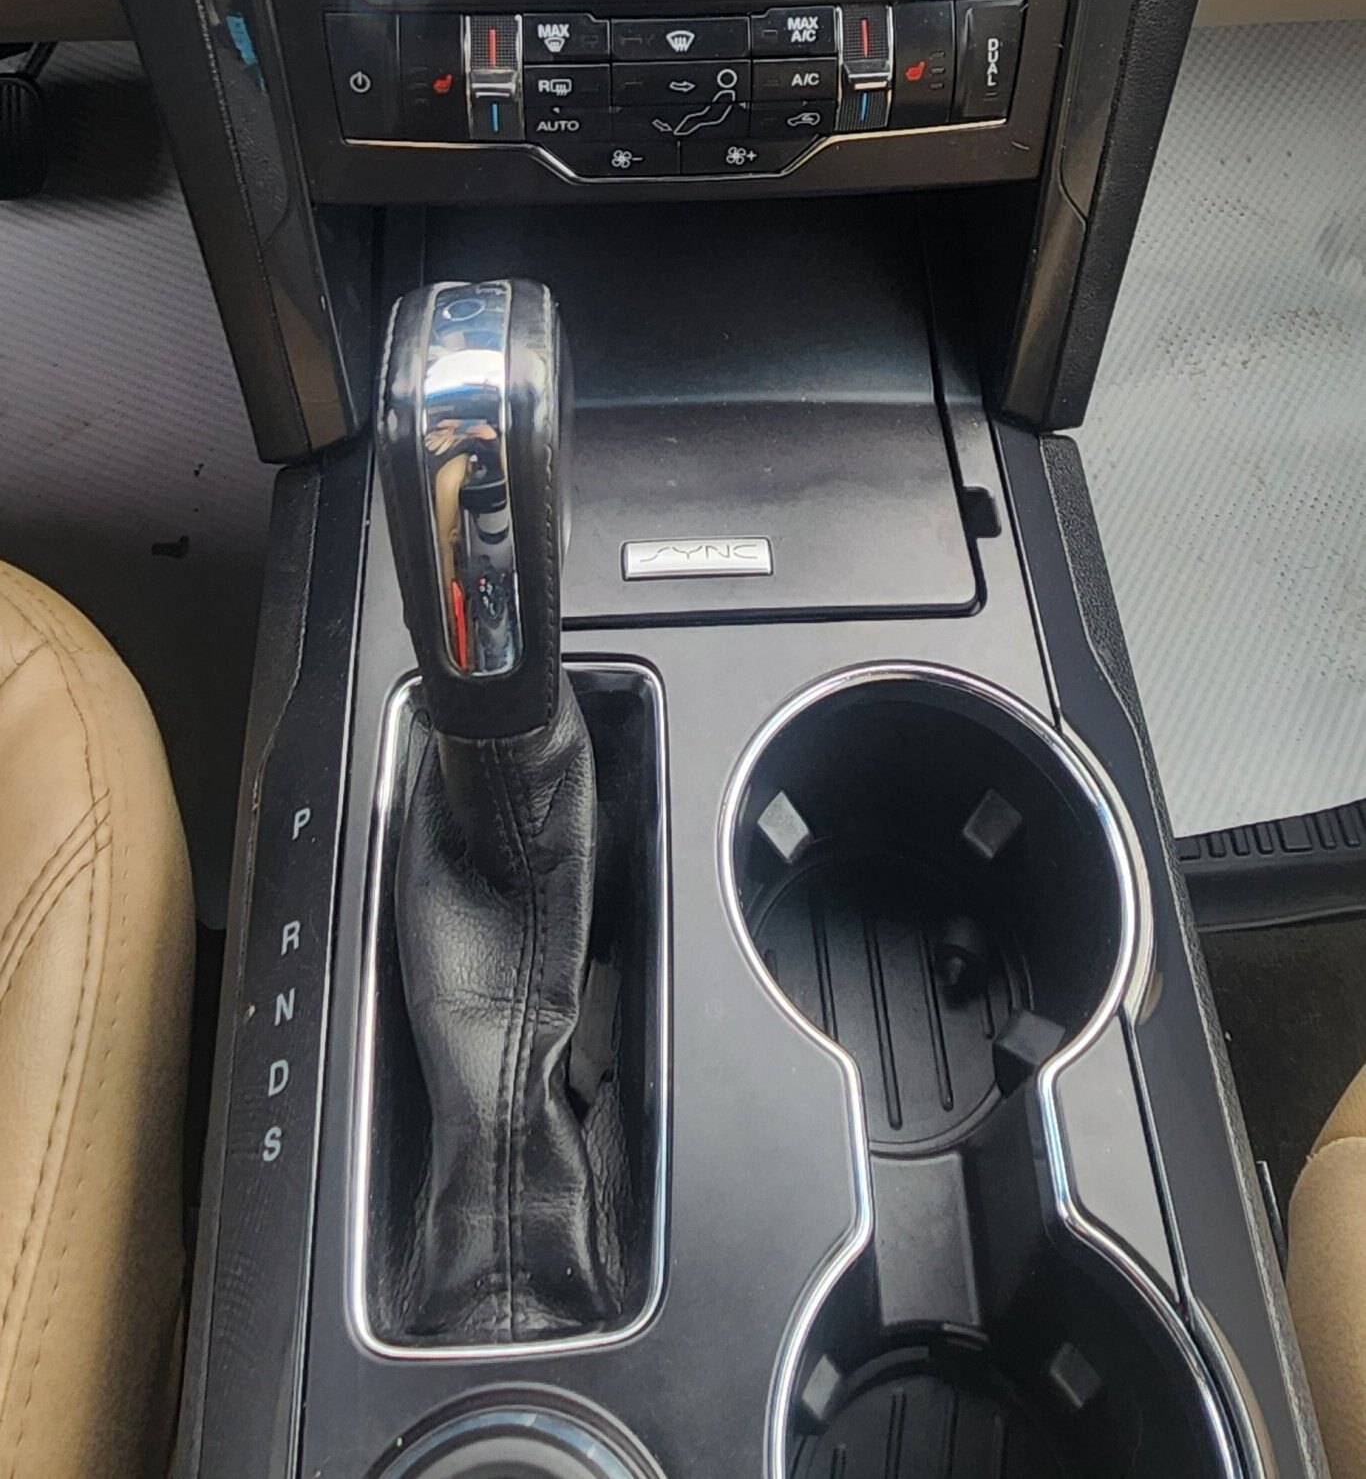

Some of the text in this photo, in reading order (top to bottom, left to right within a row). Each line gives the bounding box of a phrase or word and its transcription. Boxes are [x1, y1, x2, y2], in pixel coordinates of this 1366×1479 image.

[537, 24, 570, 39] MAX
[787, 16, 820, 30] MAX
[790, 29, 816, 43] A/C
[986, 38, 999, 87] DUAL
[538, 80, 550, 93] R
[790, 73, 820, 86] A/C
[536, 120, 580, 132] AUTO
[640, 544, 758, 563] SYNC
[292, 807, 311, 841] P
[280, 920, 301, 956] R
[274, 988, 296, 1027] N
[267, 1059, 290, 1097] D
[262, 1126, 283, 1162] S
